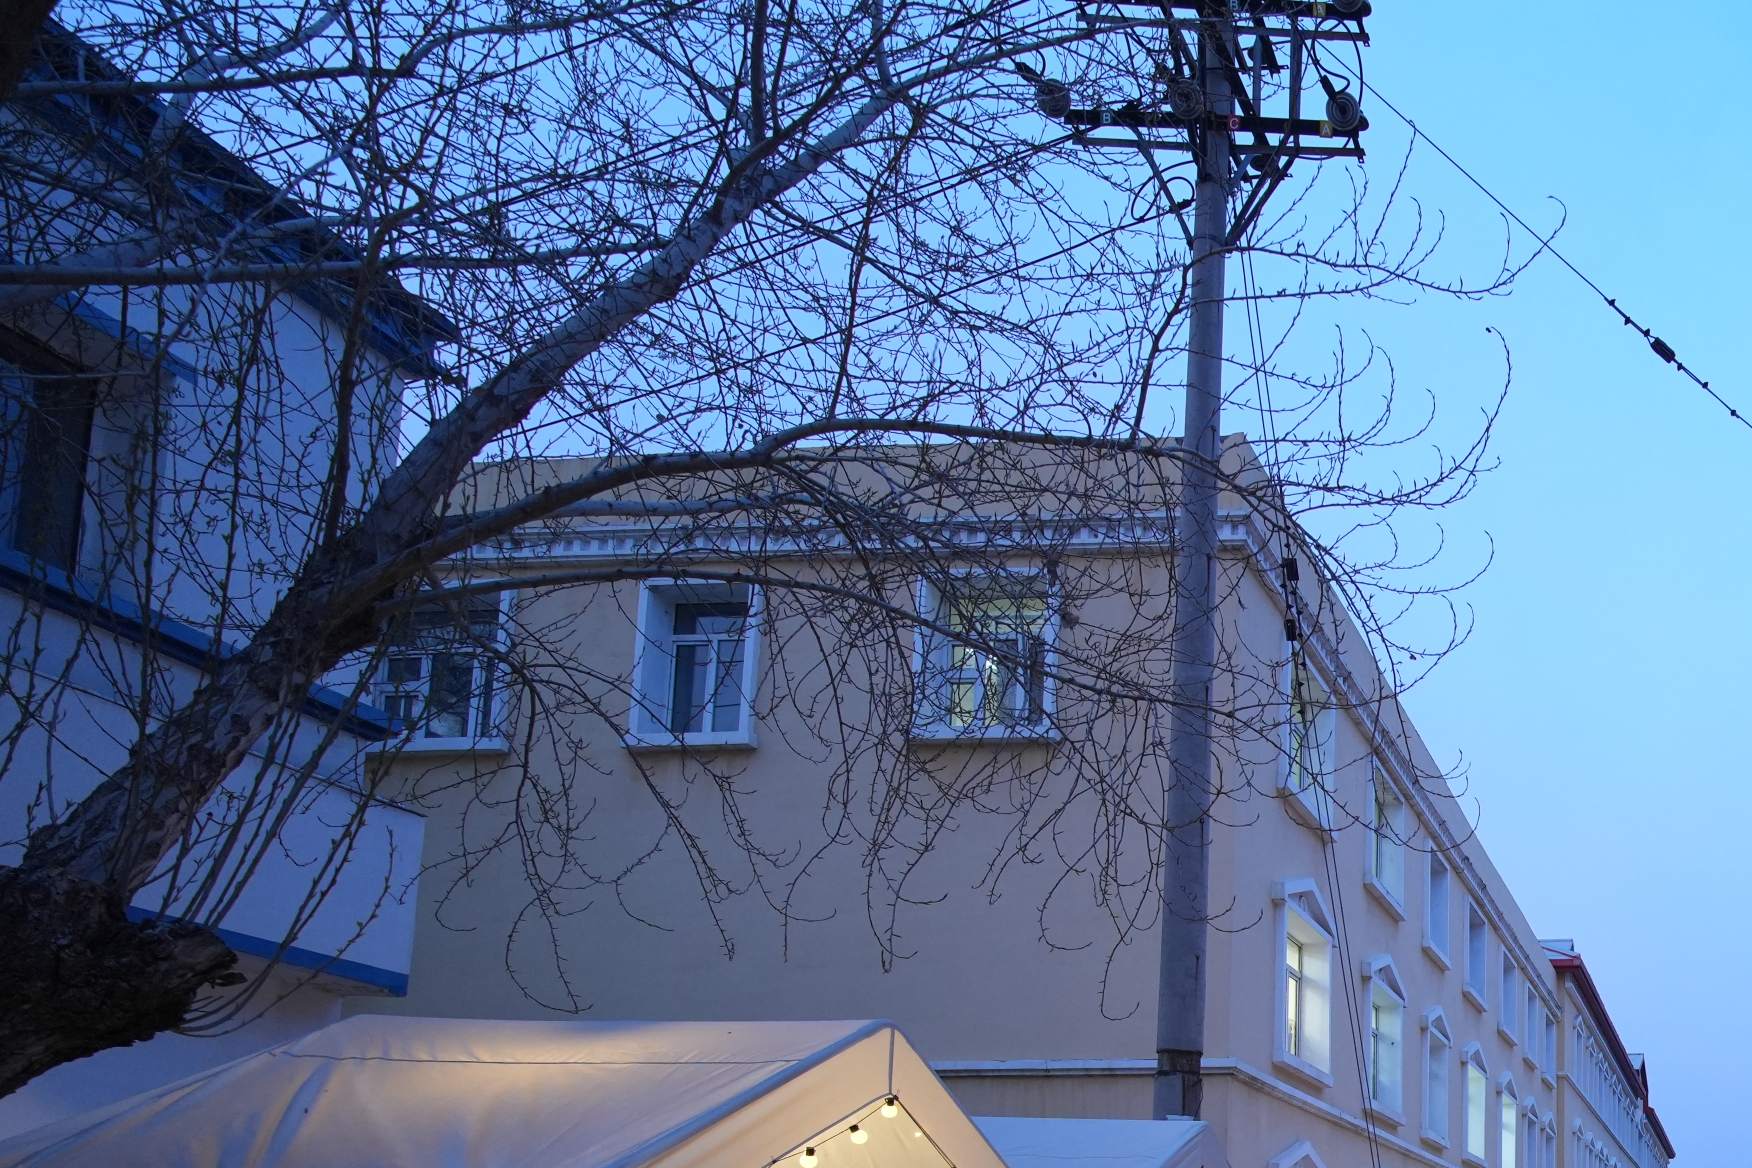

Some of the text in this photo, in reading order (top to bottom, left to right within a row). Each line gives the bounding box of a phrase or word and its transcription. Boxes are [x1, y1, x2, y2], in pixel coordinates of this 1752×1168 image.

[1103, 112, 1111, 123] B
[1230, 118, 1239, 129] C
[1321, 125, 1331, 136] A
